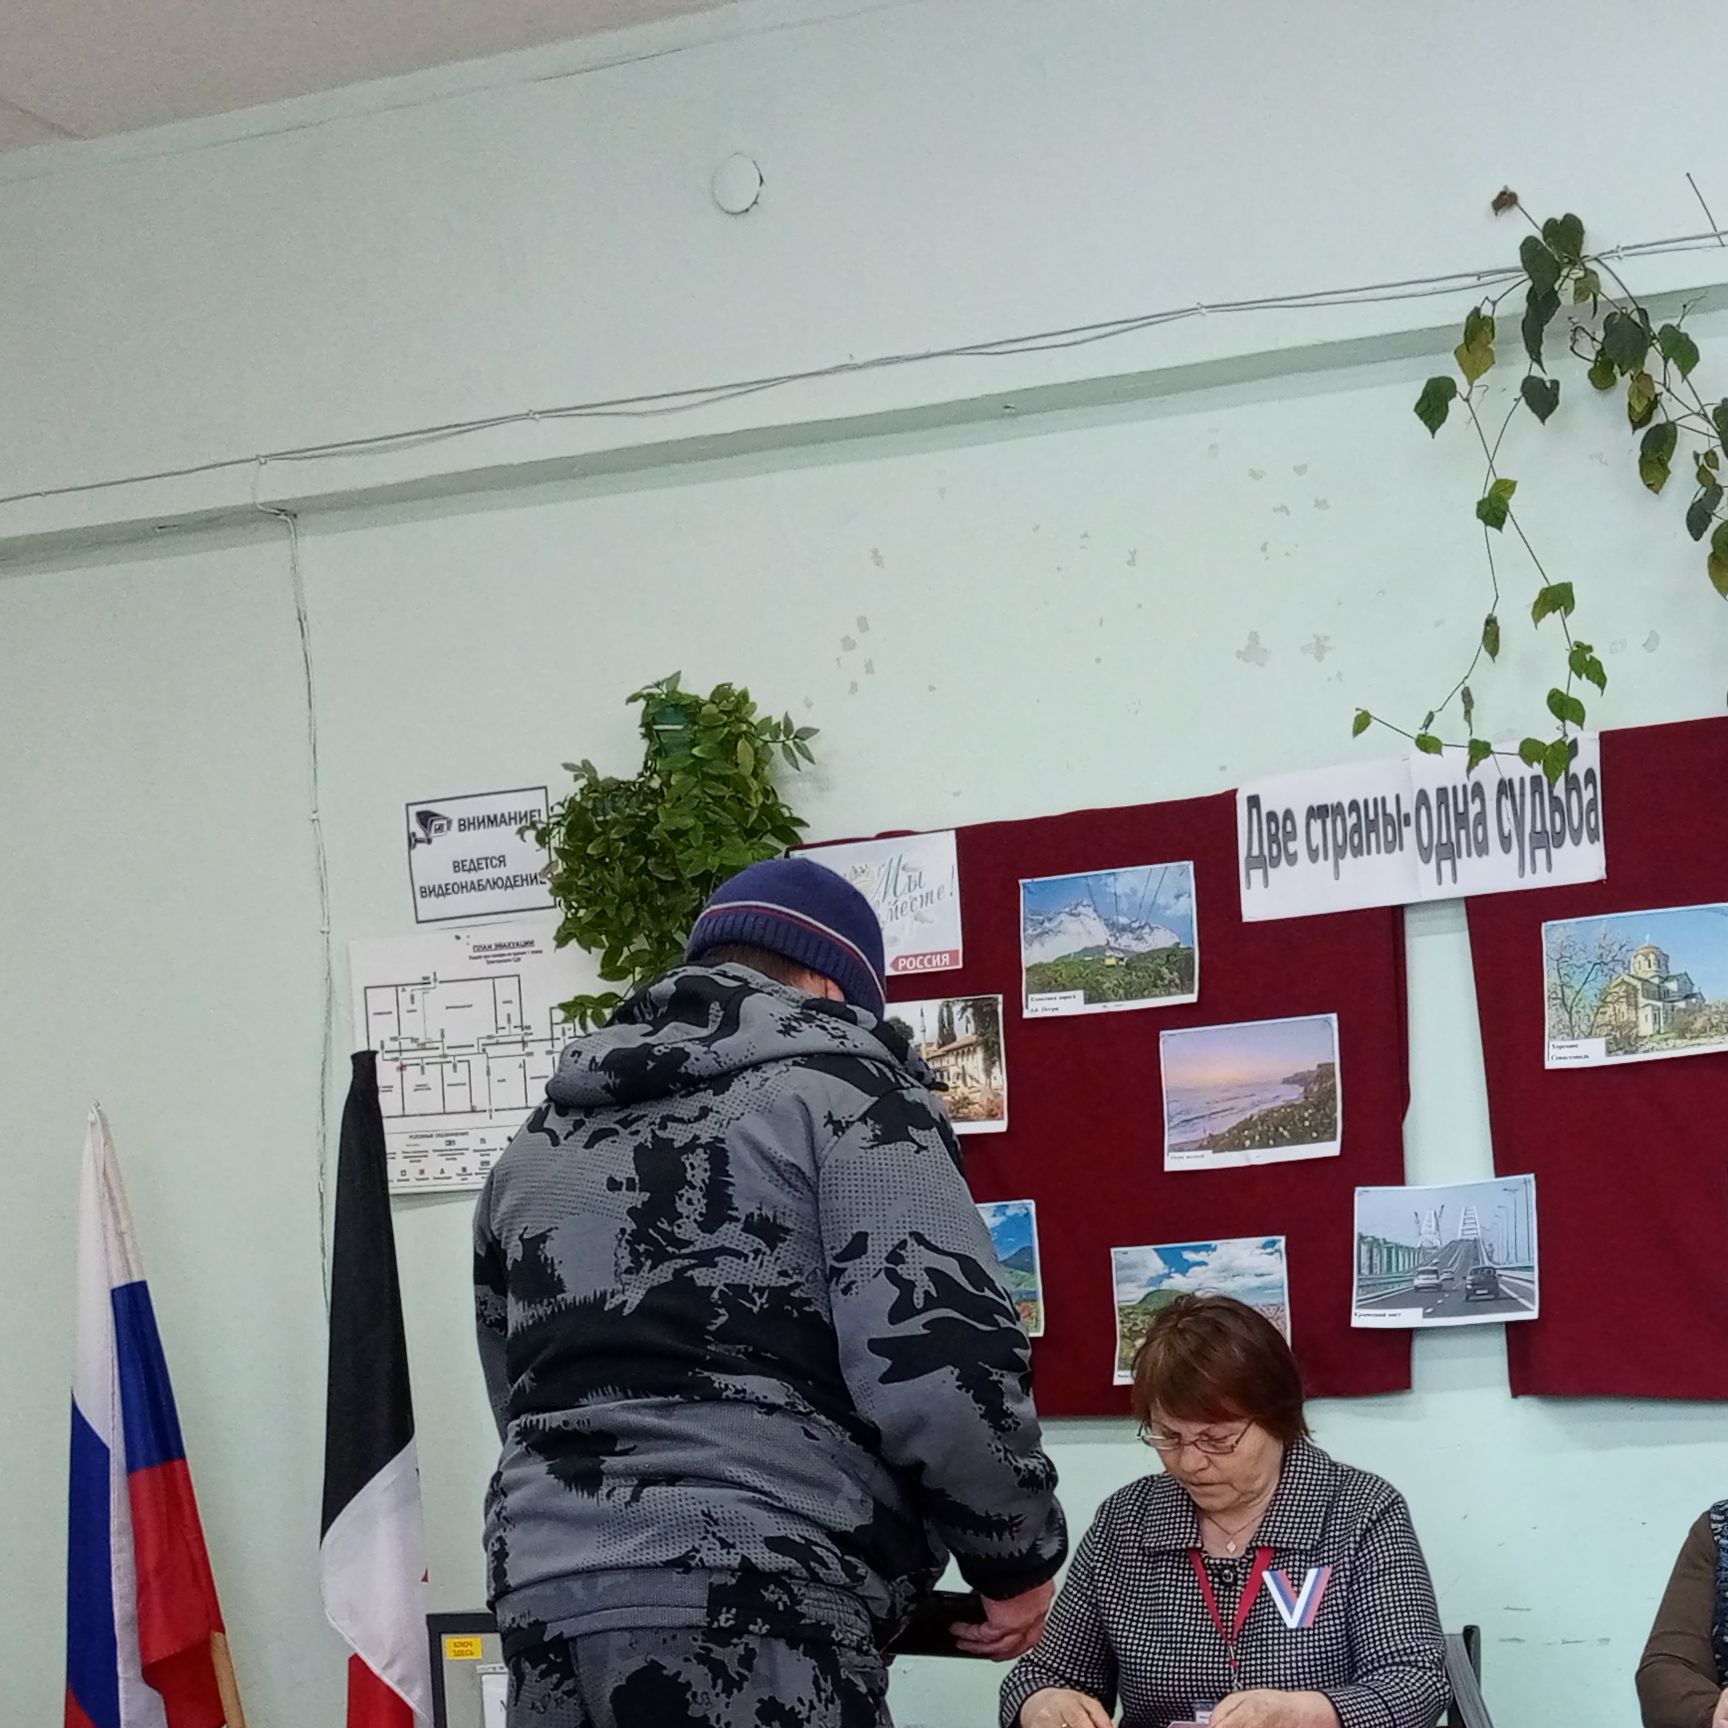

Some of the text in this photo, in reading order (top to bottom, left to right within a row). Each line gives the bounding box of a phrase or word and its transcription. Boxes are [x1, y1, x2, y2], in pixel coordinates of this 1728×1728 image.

[457, 808, 542, 833] ВНИМАНИЕ!
[1244, 793, 1298, 890] Две
[1495, 737, 1600, 879] судьба
[452, 854, 507, 874] ВЕДЕТСЯ
[898, 953, 950, 970] РОССИЯ
